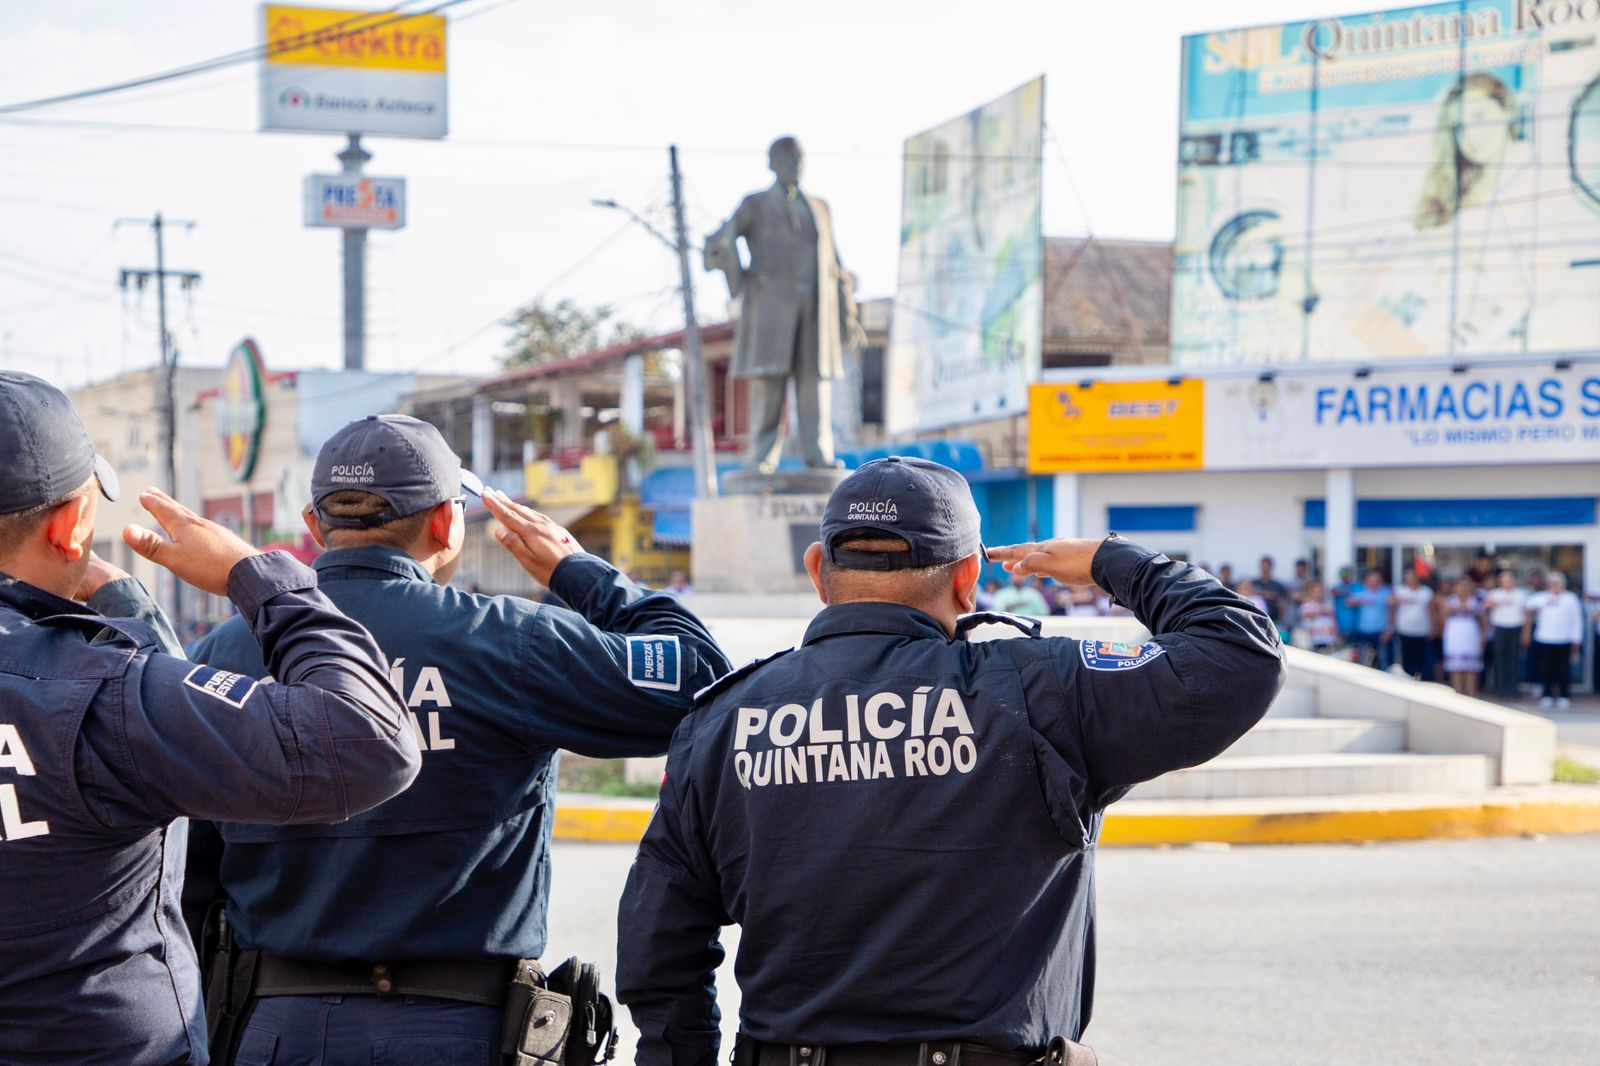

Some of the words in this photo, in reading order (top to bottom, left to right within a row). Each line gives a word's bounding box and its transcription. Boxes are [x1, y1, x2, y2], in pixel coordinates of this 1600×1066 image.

[1303, 7, 1499, 63] Quintana
[1512, 0, 1600, 33] Roo
[1315, 379, 1566, 425] FARMACIAS
[1445, 425, 1512, 445] MISMO
[1517, 423, 1575, 442] PERO
[331, 461, 375, 475] POLICÍA
[331, 475, 359, 484] QUINTANA
[360, 475, 375, 484] ROO
[848, 513, 880, 521] QUINTANA
[881, 513, 898, 522] ROO
[849, 499, 898, 514] POLICÍA
[734, 685, 974, 751] POLICÍA
[734, 740, 895, 791] QUINTANA
[904, 735, 978, 777] ROO
[0, 783, 51, 842] L
